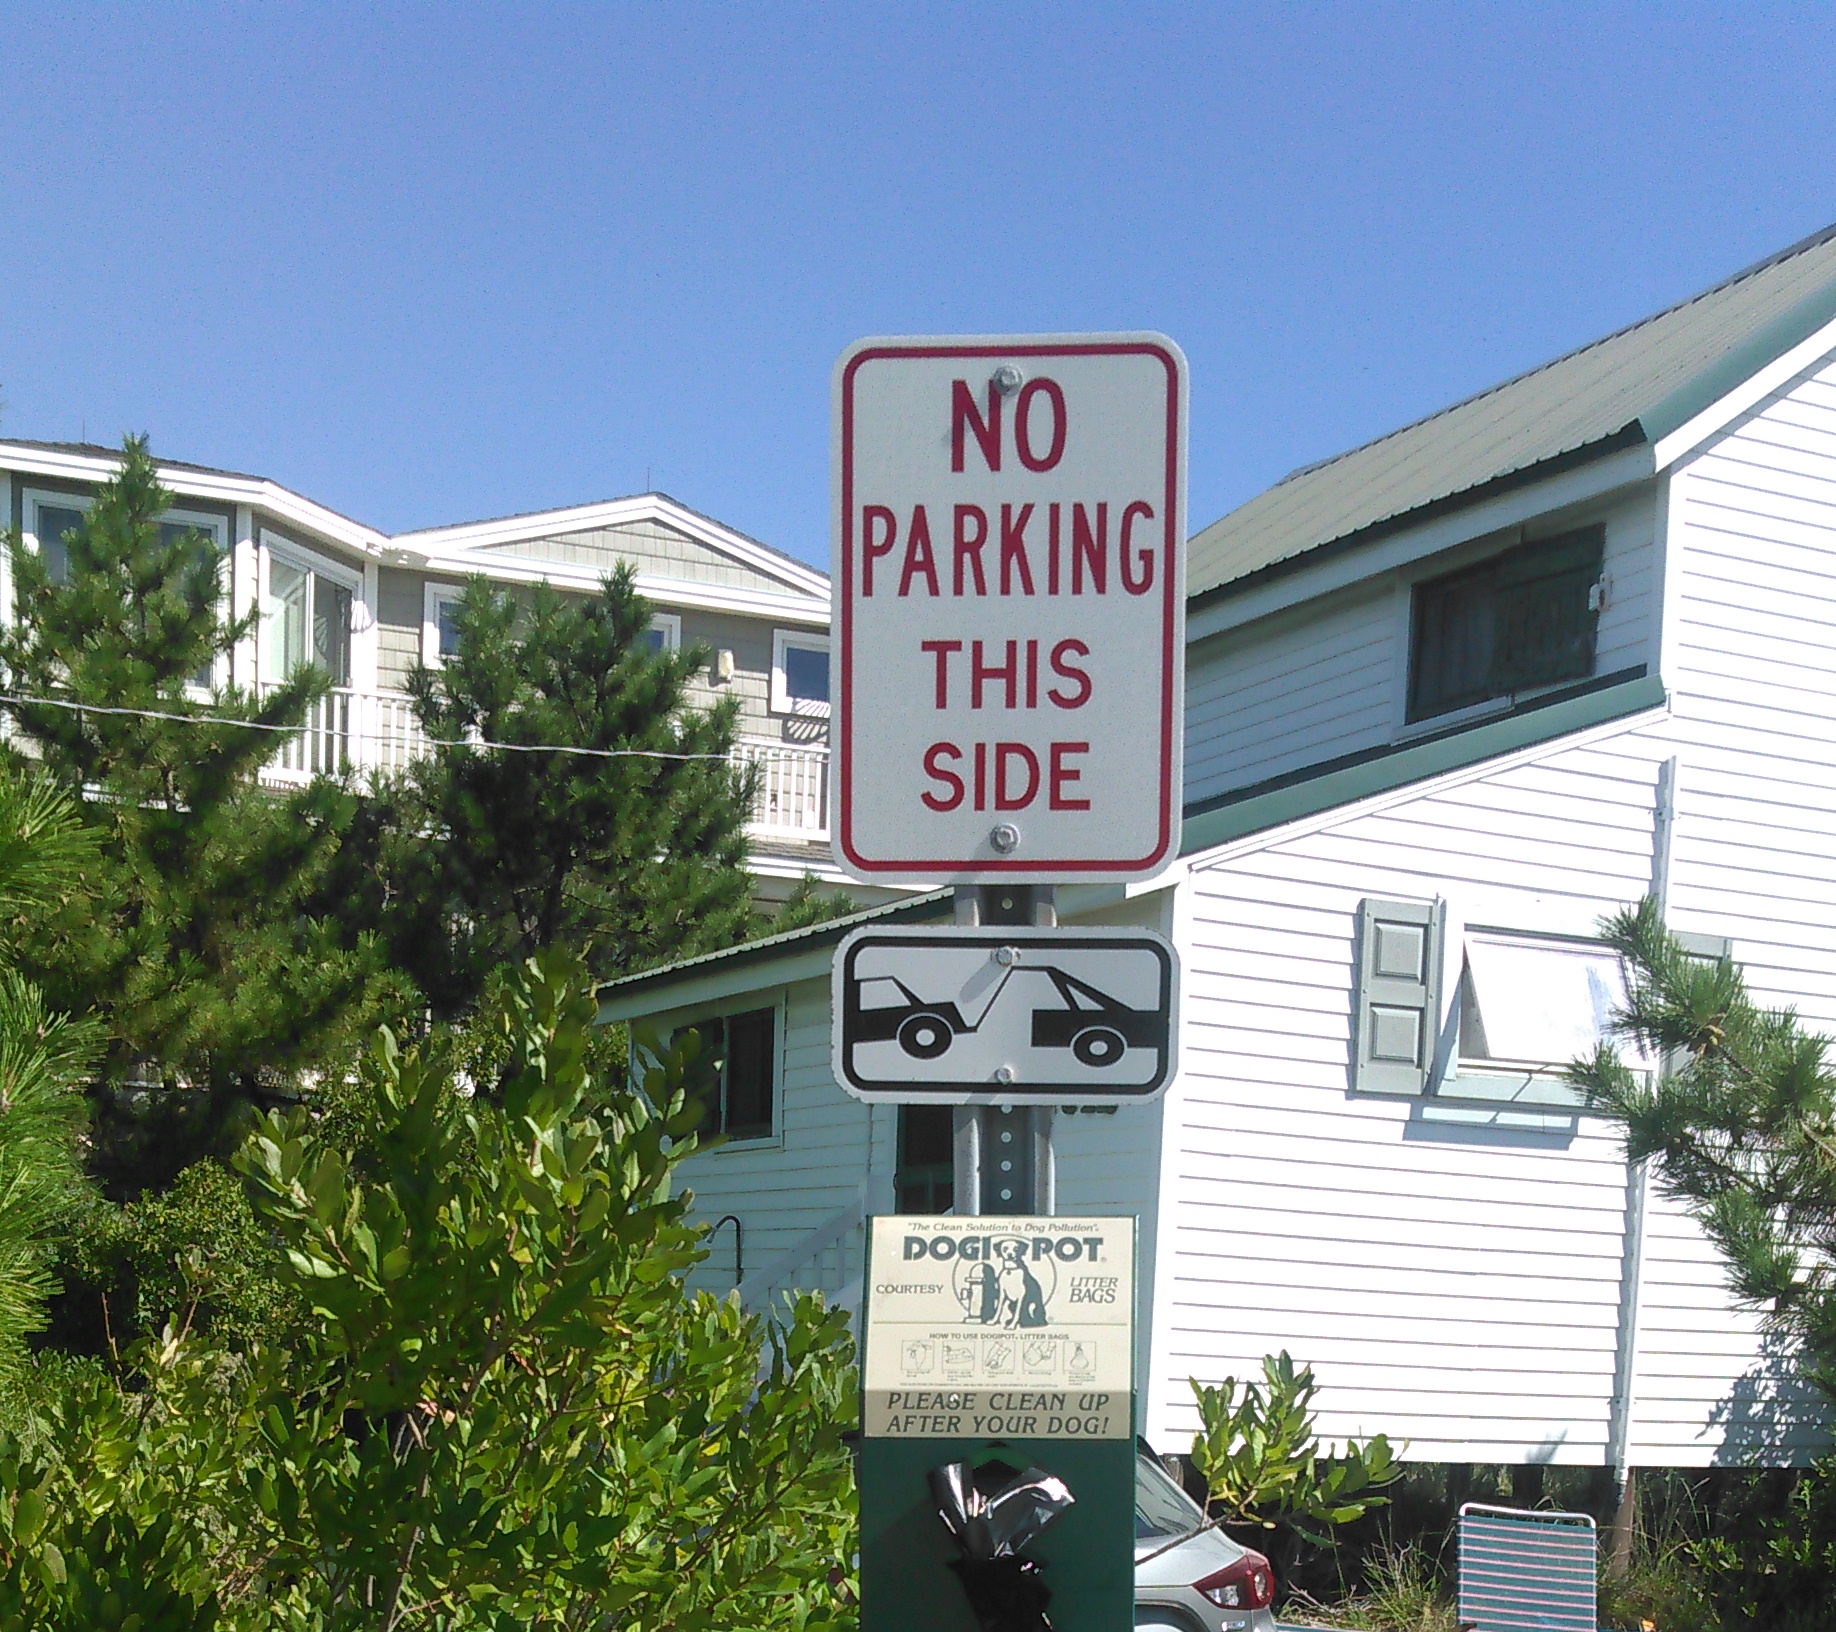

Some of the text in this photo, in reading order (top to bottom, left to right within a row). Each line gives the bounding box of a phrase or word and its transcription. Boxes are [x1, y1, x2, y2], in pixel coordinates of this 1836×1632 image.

[952, 377, 1066, 473] NO
[862, 501, 1155, 597] PARKING
[921, 639, 1092, 709] THIS
[920, 742, 1090, 812] SIDE
[933, 1223, 962, 1232] Clean
[966, 1223, 1008, 1232] Solution
[1011, 1223, 1022, 1232] to
[1024, 1223, 1045, 1233] Dog
[876, 1284, 944, 1294] COURTESY
[1070, 1276, 1118, 1288] LITTER
[1069, 1288, 1117, 1303] BAGS
[887, 1392, 1110, 1411] PLEASE CLEAN UP
[886, 1415, 1110, 1434] AFTER YOUR DOG!
